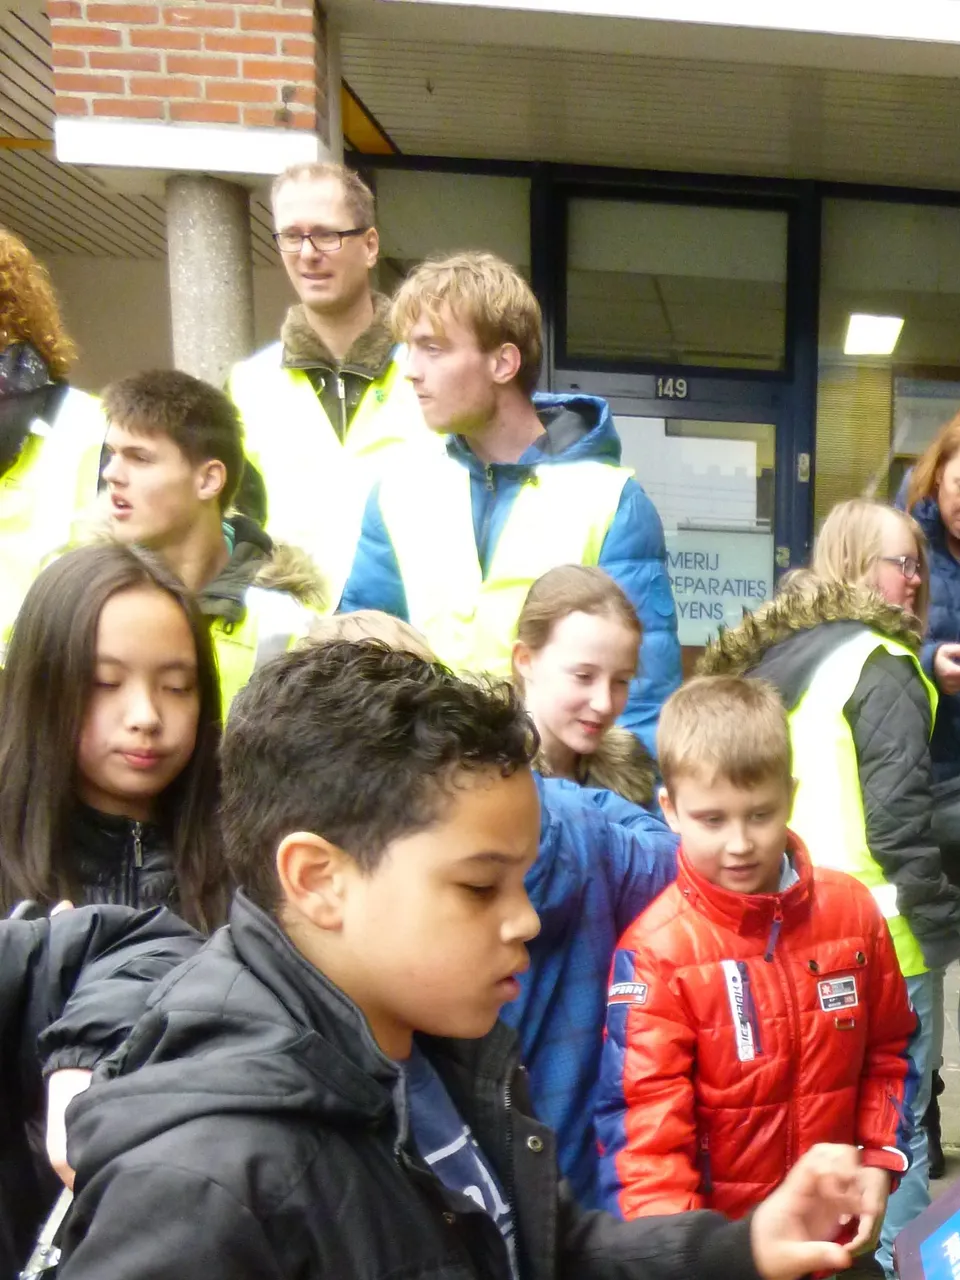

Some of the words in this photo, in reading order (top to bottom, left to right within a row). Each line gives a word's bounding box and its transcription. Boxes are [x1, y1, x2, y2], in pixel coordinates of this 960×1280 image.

[657, 378, 687, 398] 149
[666, 551, 719, 571] MERIJ
[677, 602, 724, 620] YENS
